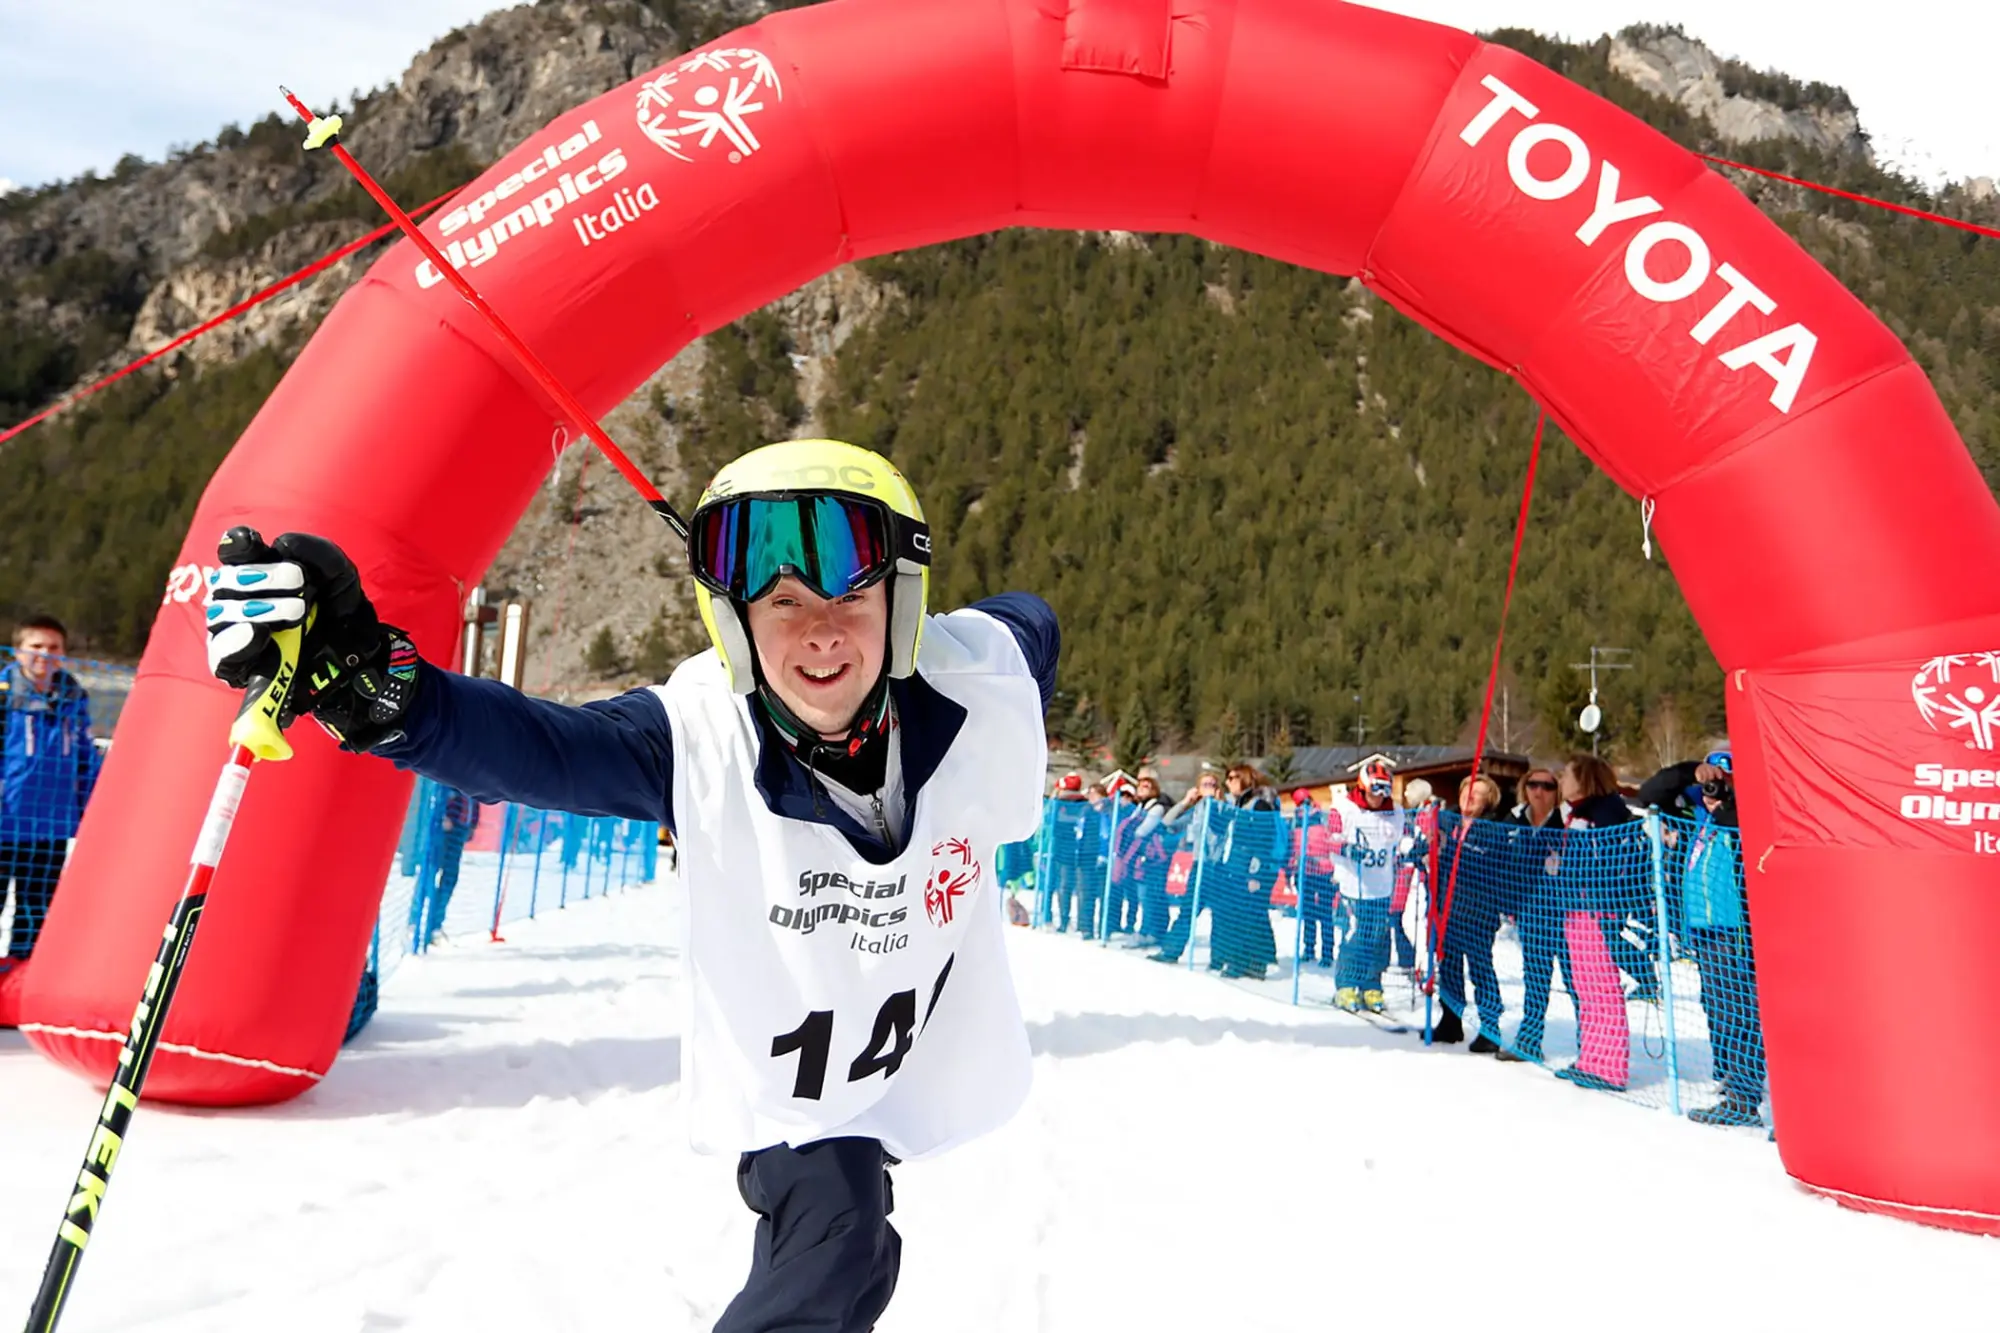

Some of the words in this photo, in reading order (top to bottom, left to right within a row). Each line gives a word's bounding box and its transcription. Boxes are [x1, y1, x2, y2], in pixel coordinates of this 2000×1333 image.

[438, 119, 602, 237] Special
[415, 147, 628, 289] Olympics
[572, 182, 660, 247] Italia
[1459, 73, 1819, 414] TOYOTA
[262, 660, 294, 719] LEKI
[1913, 763, 2000, 793] Spe
[799, 869, 907, 899] Special
[769, 903, 908, 935] Olympics
[850, 931, 909, 954] Italia
[59, 1081, 138, 1250] LEKI
